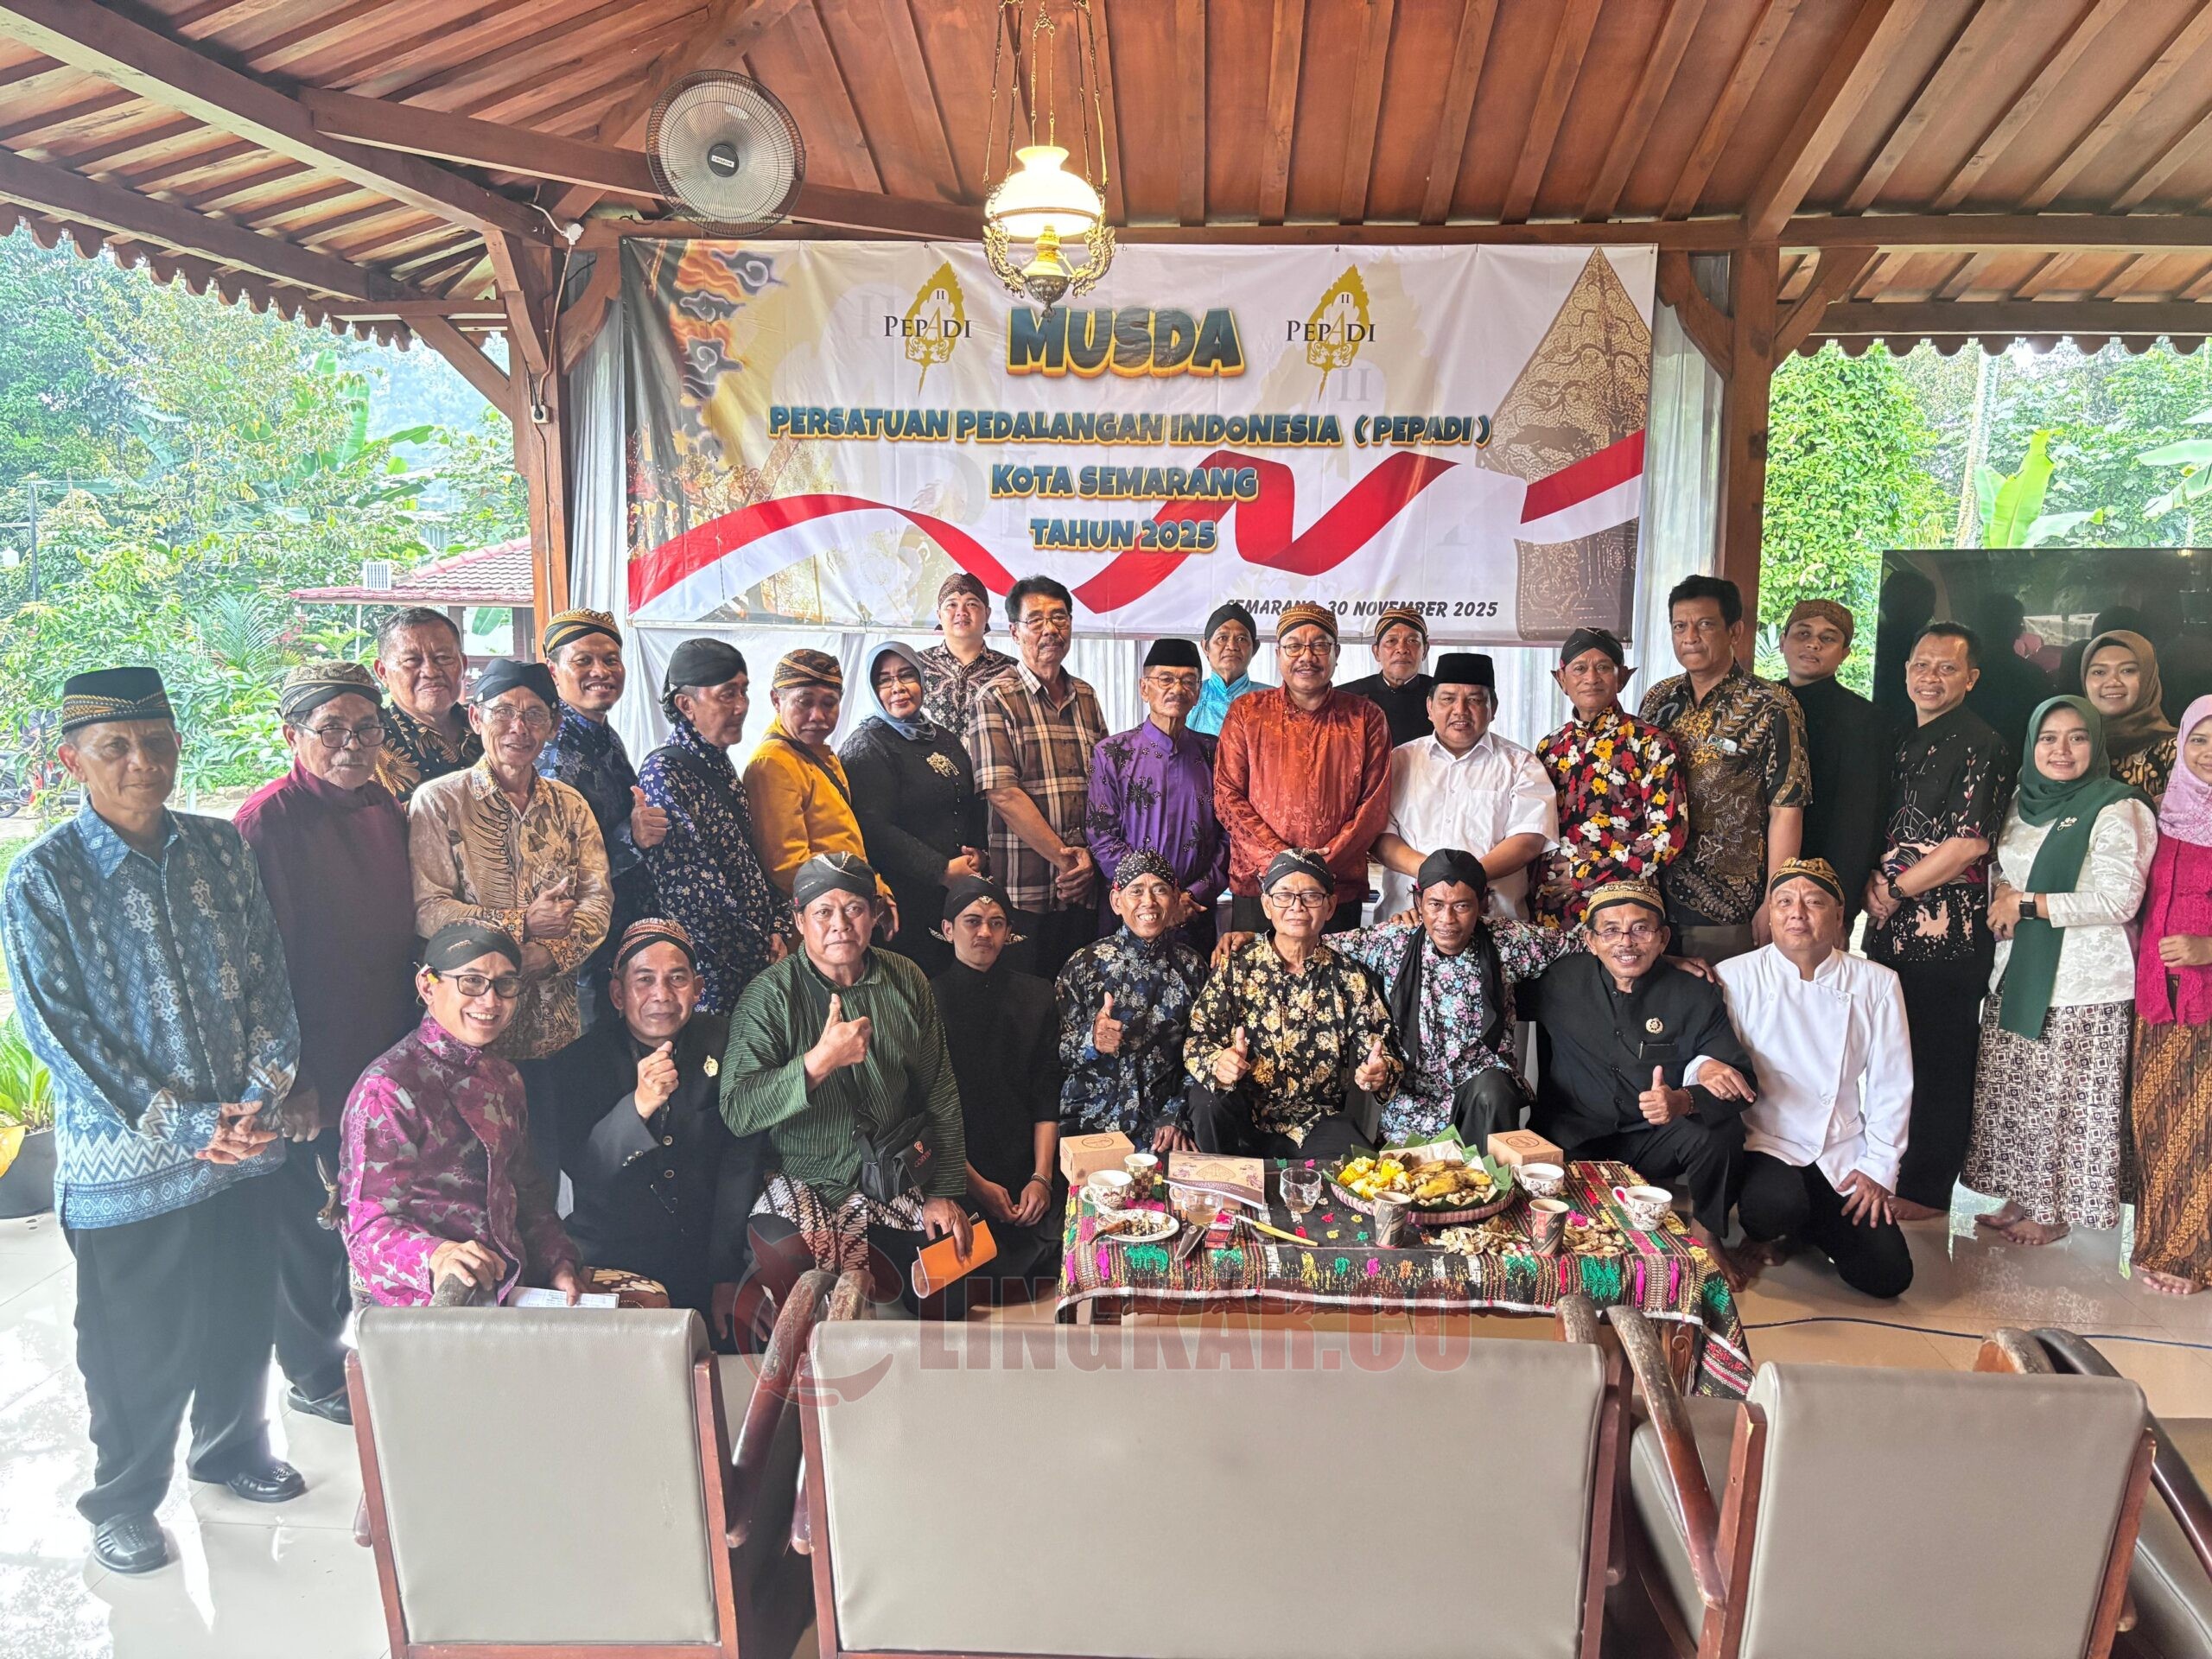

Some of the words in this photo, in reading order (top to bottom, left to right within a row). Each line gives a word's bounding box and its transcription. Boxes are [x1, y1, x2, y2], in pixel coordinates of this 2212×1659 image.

[883, 306, 972, 341] PEPADI
[1007, 305, 1245, 378] MUSDA
[1286, 310, 1376, 346] PEPADI
[768, 406, 950, 440] PERSATUAN
[954, 409, 1164, 444] PEDALANGAN
[1168, 413, 1343, 447] INDONESIA
[989, 464, 1075, 499] KOTA
[1078, 465, 1259, 501] SEMARANG
[1029, 518, 1135, 551] TAHUN
[1140, 519, 1218, 553] 2025
[1327, 601, 1348, 615] 30
[1453, 601, 1499, 617] 2025
